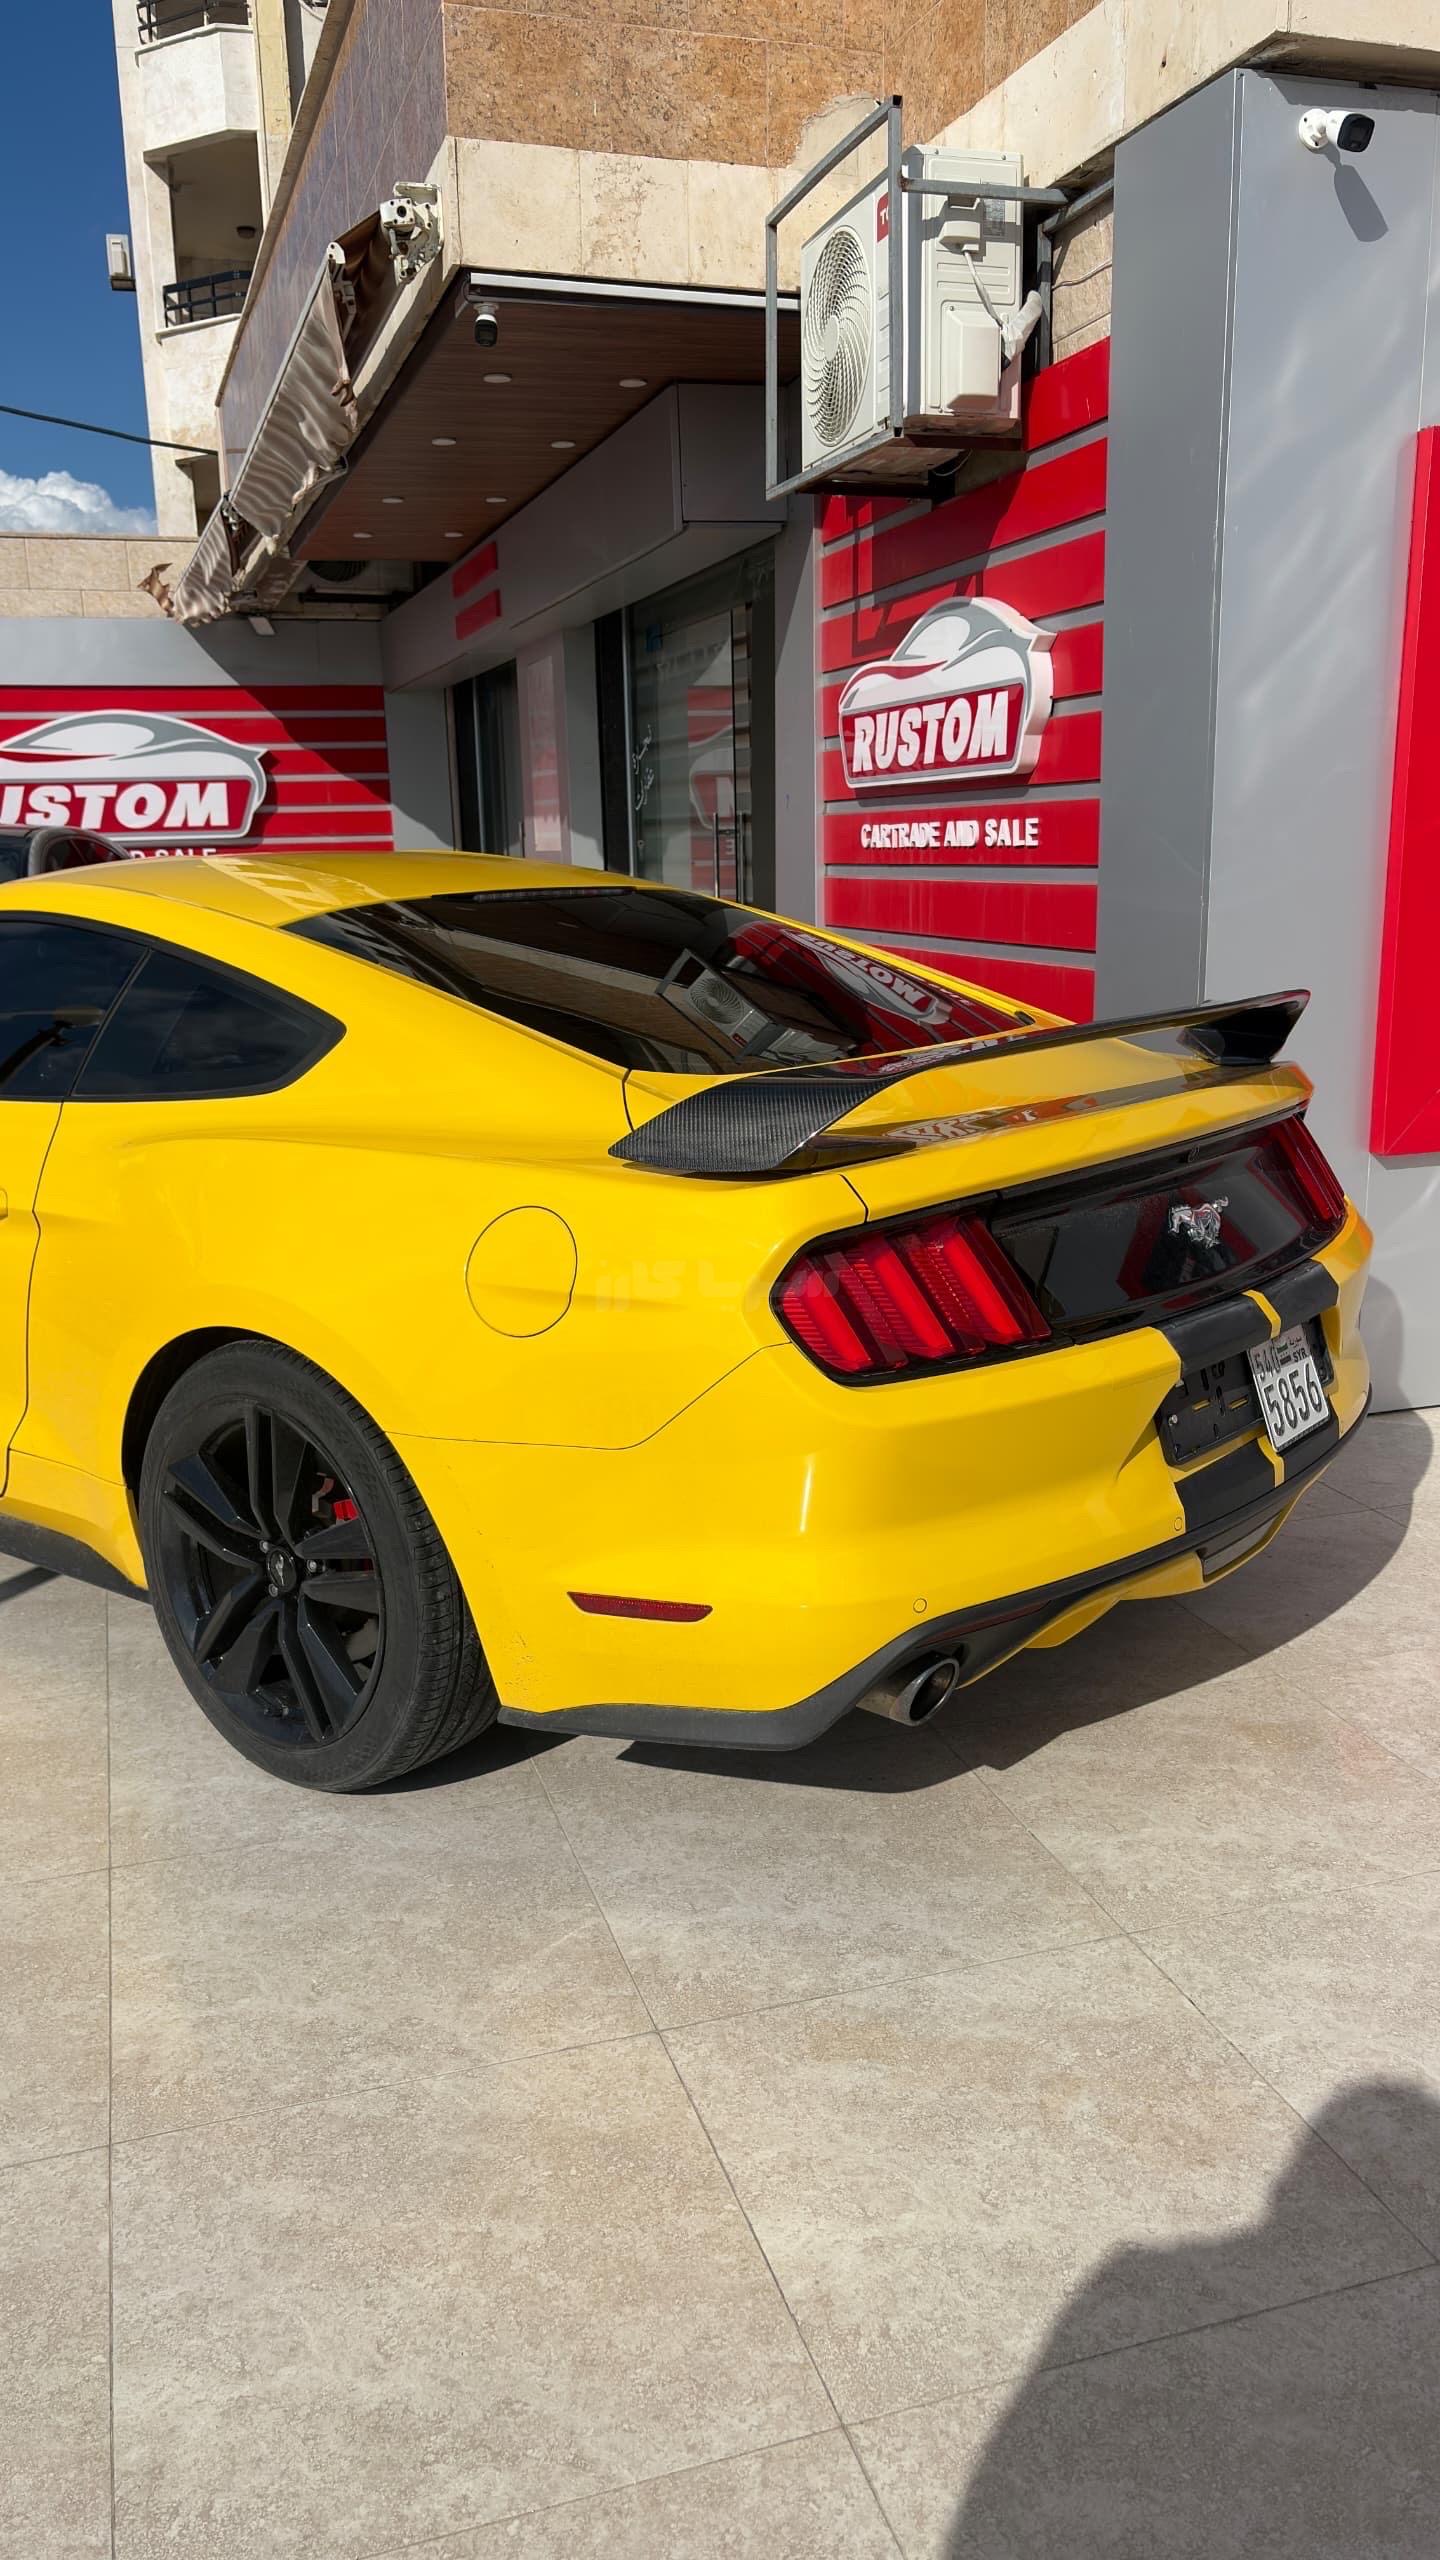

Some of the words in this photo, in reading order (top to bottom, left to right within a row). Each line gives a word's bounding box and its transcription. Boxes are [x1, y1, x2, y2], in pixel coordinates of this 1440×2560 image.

[852, 690, 1009, 773] RUSTOM
[861, 822, 941, 848] CARTRADE
[943, 819, 980, 848] AND
[984, 817, 1040, 847] SALE
[1292, 1347, 1308, 1363] SYR
[1263, 1362, 1324, 1438] 5856
